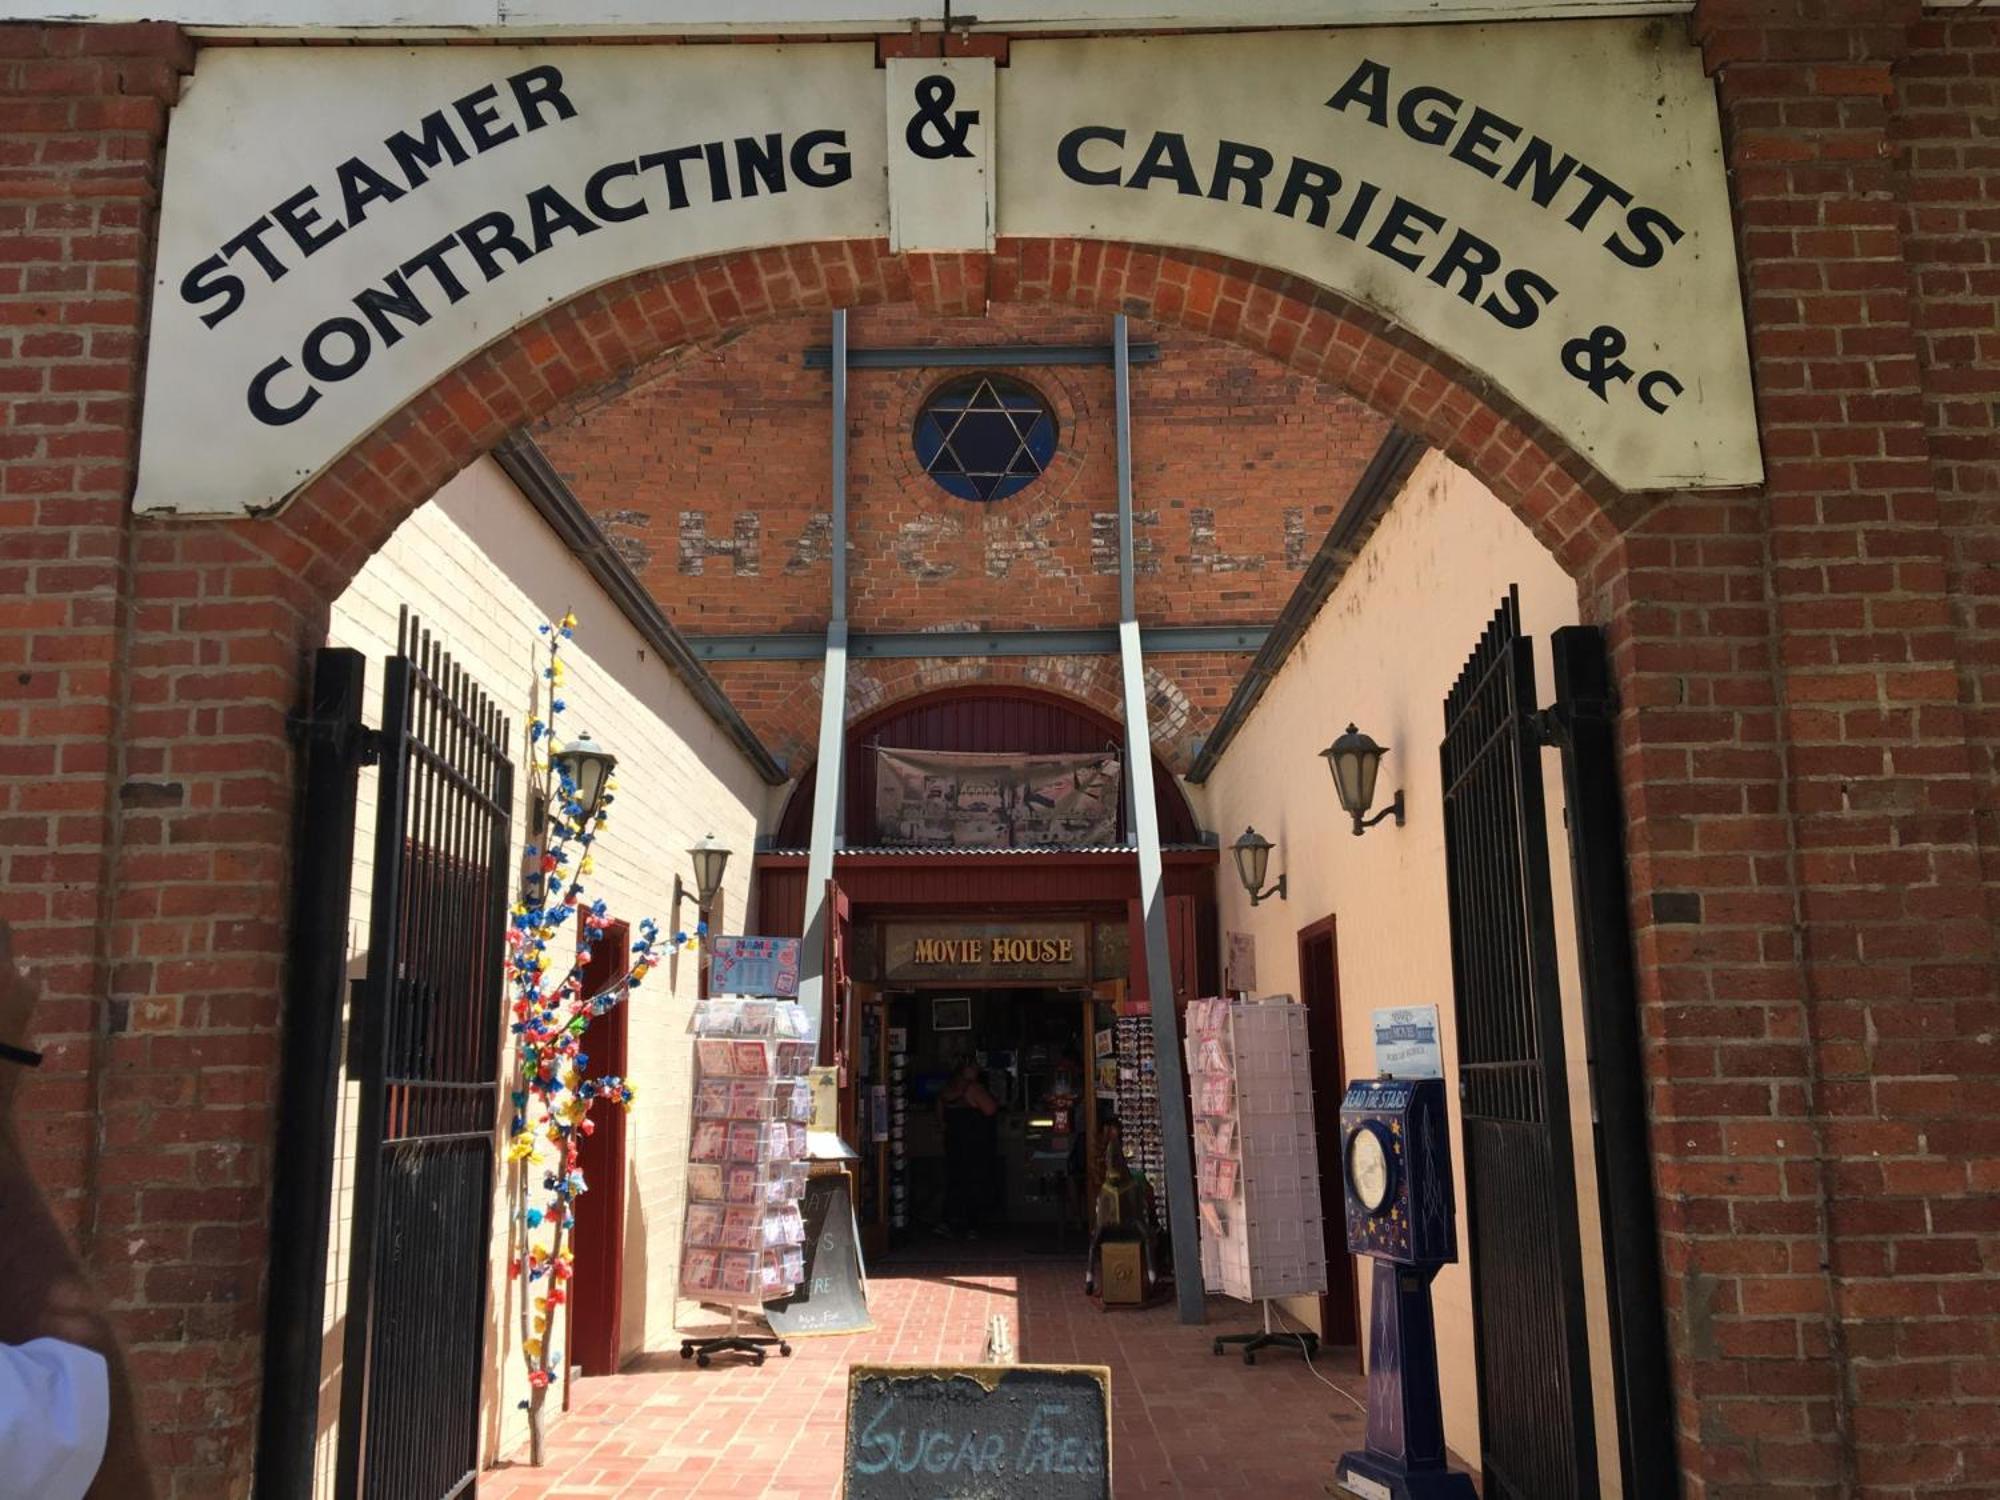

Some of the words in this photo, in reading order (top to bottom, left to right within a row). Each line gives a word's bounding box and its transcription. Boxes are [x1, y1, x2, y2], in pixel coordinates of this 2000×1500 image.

[179, 64, 579, 330] STEAMER
[905, 74, 980, 160] &
[1325, 58, 1686, 269] AGENTS
[246, 129, 853, 427] CONTRACTING
[1057, 125, 1560, 330] CARRIERS
[915, 938, 982, 963] MOVIE
[991, 937, 1073, 963] HOUSE
[856, 1397, 1006, 1473] SUGAR
